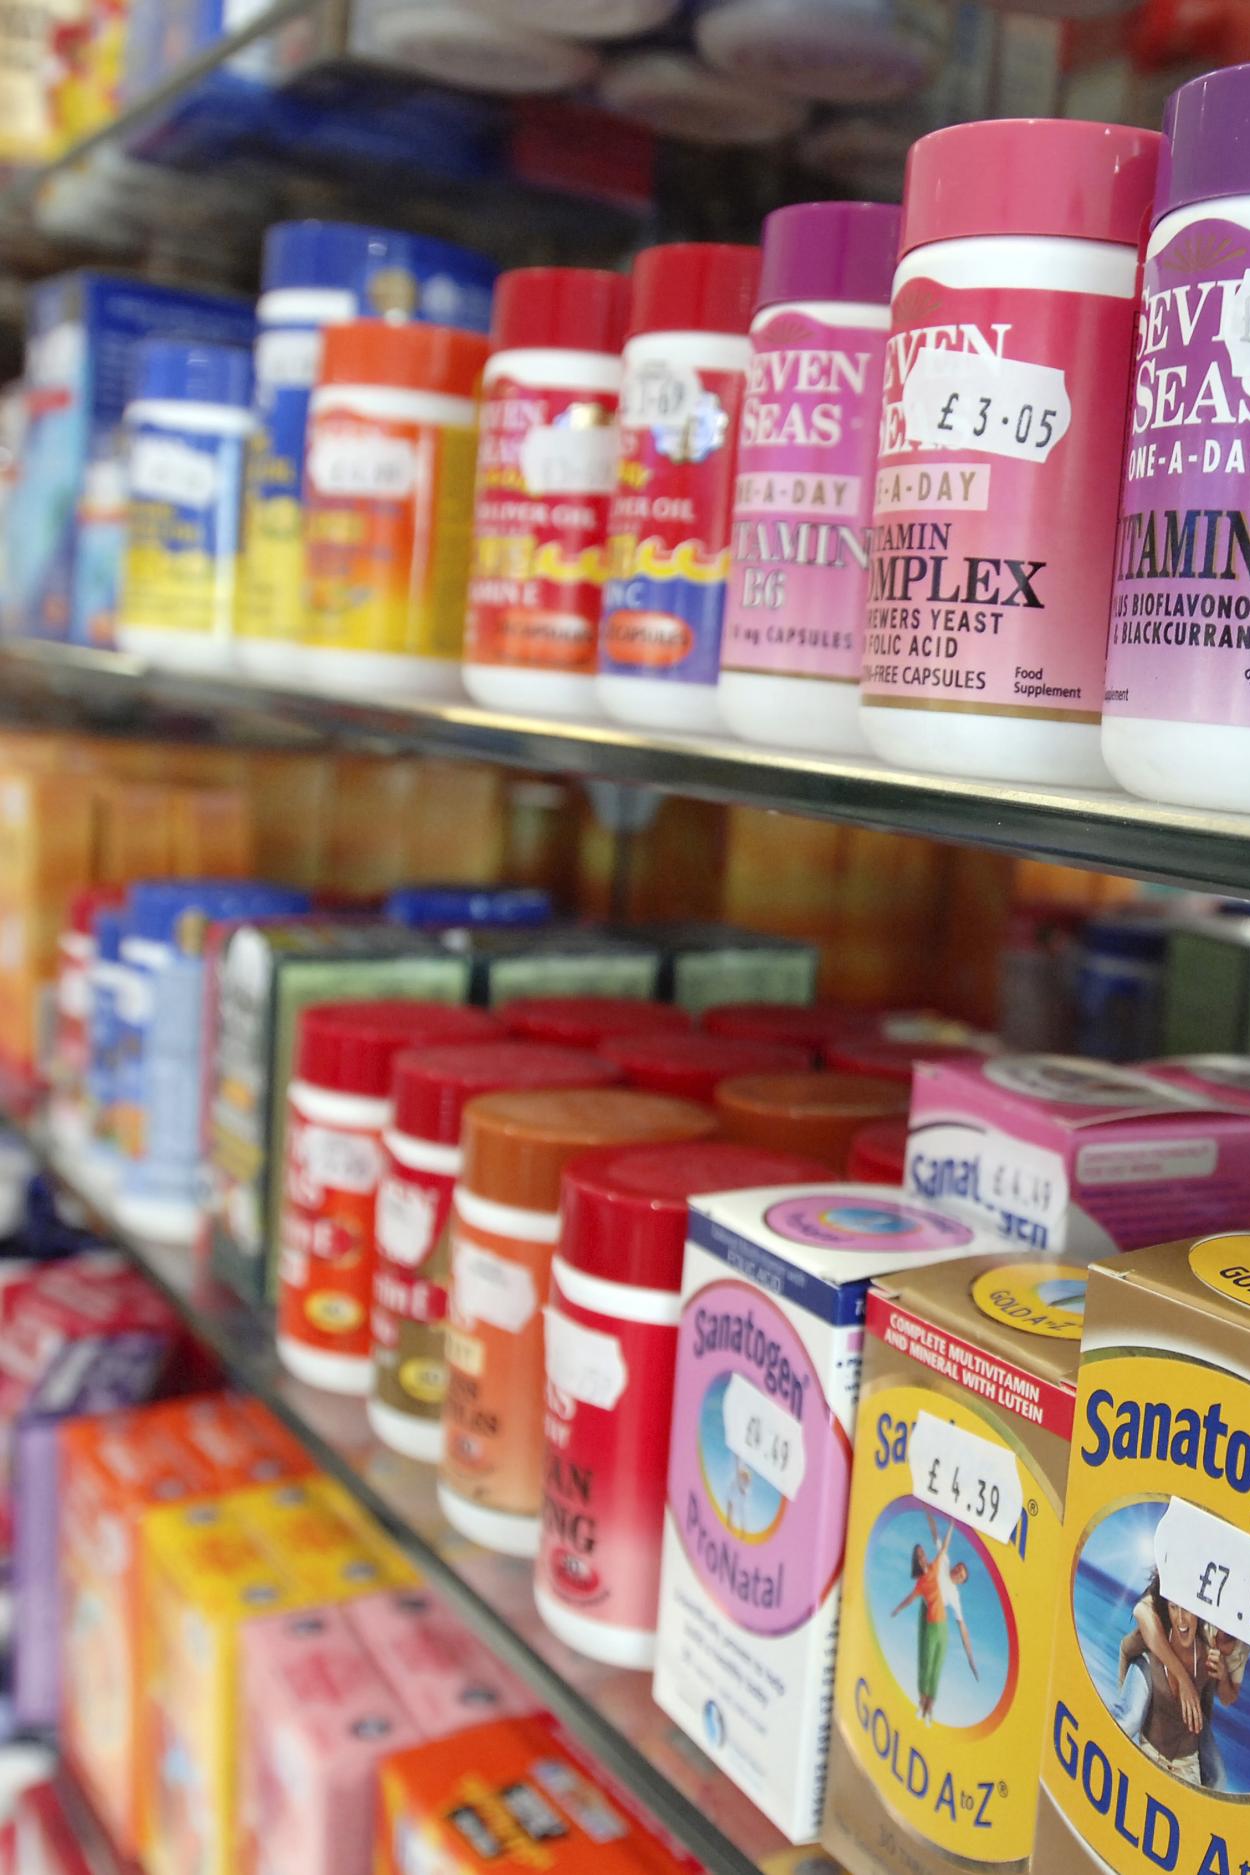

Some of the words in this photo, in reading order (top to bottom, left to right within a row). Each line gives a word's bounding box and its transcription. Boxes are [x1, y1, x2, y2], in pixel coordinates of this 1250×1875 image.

[748, 350, 871, 395] EVEN
[733, 520, 873, 571] TAMIN
[766, 623, 854, 650] CAPSULES
[908, 635, 959, 659] ACID
[930, 609, 1004, 635] YEAST
[901, 665, 987, 691] CAPSULES
[1013, 682, 1082, 699] Supplement
[1015, 667, 1044, 681] Food
[693, 1308, 806, 1424] Sanatogen
[883, 1328, 908, 1352] AND
[909, 1340, 959, 1381] MINERAL
[961, 1366, 997, 1401] WITH
[997, 1385, 1044, 1425] LUTEIN
[889, 1312, 948, 1355] COMPLETE
[948, 1341, 1041, 1403] MULTIVITAMIN
[927, 1457, 1001, 1523] £4.39
[686, 1491, 785, 1609] ProNatal
[854, 1676, 930, 1800] GOLD
[1053, 1700, 1180, 1872] GOLD
